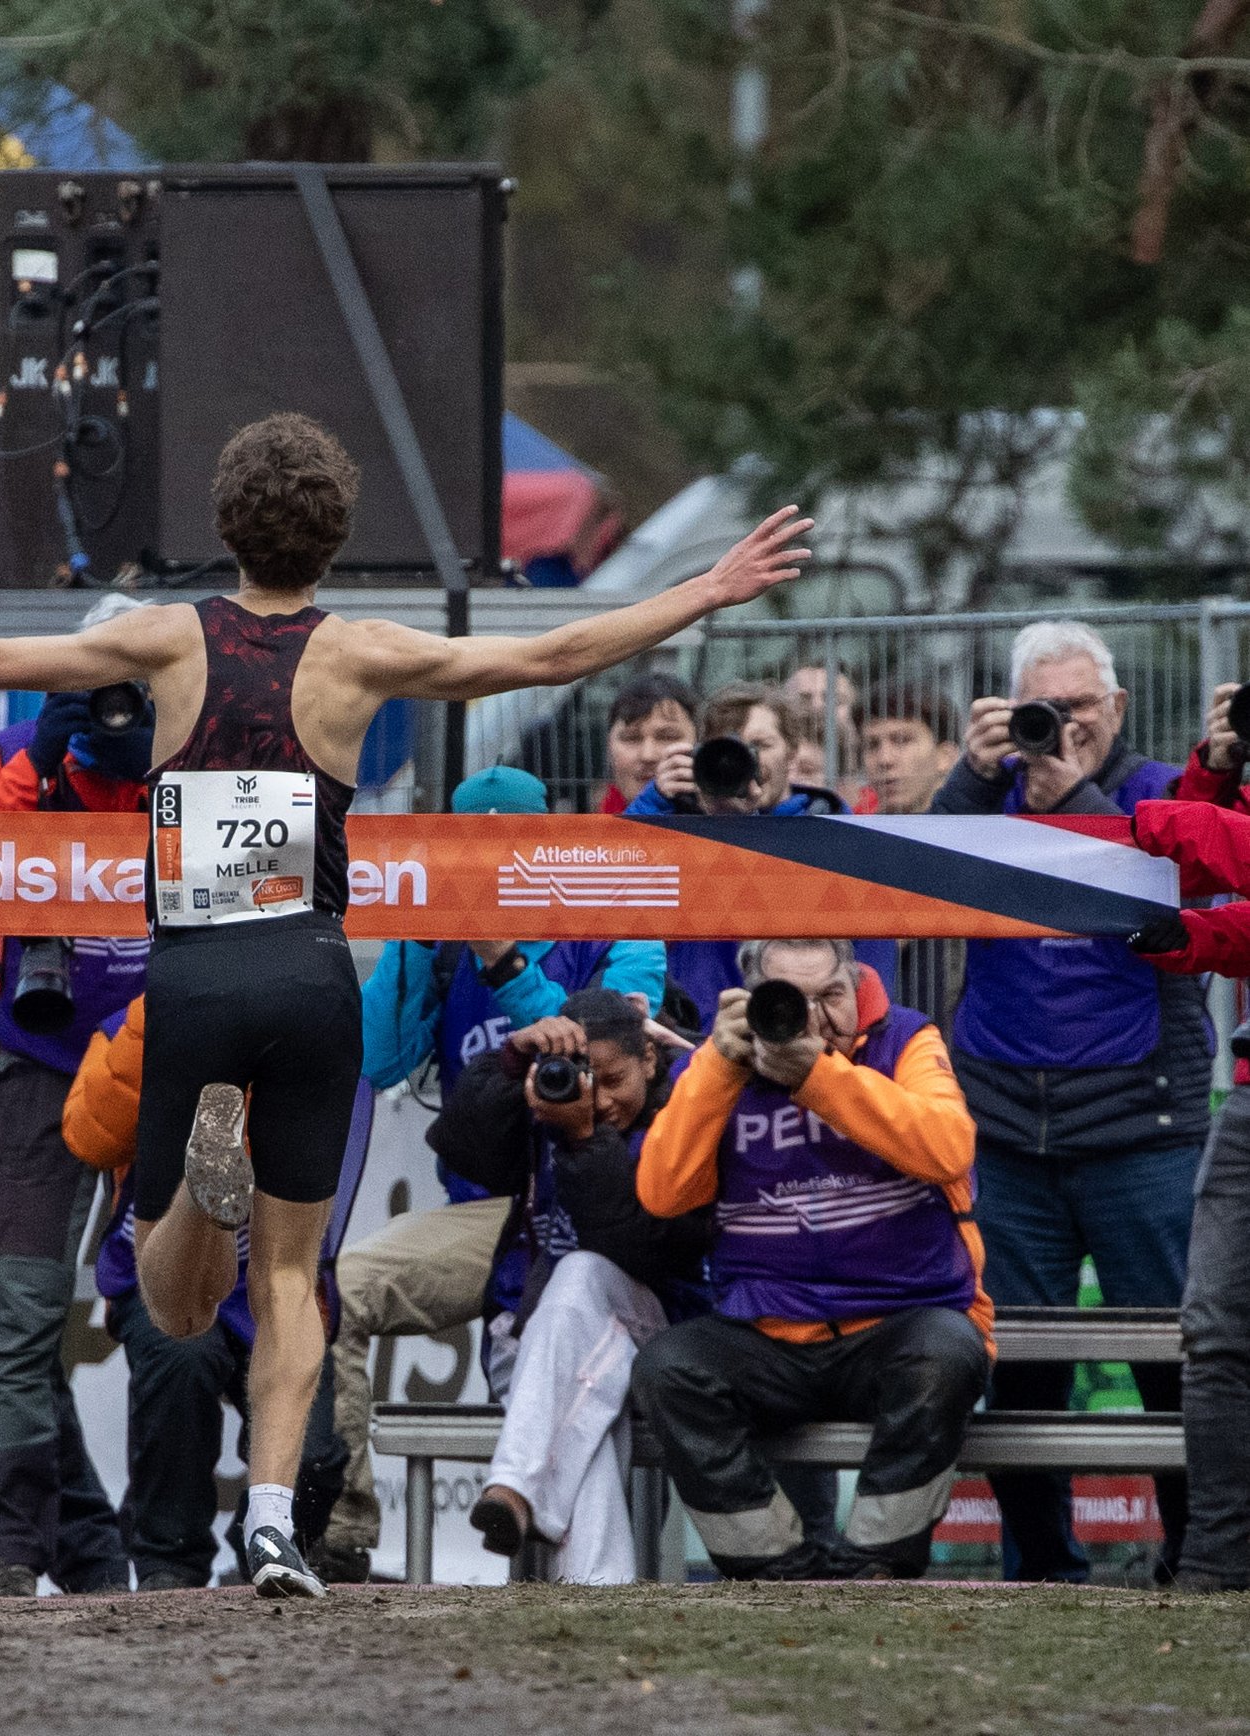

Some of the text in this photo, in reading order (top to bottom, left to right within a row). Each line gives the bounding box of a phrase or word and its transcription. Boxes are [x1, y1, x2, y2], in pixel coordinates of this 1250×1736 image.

[158, 786, 179, 825] capi
[234, 796, 260, 804] TRIBE
[216, 819, 289, 849] 720
[532, 845, 647, 863] Atletiekunie
[216, 859, 280, 878] MELLE
